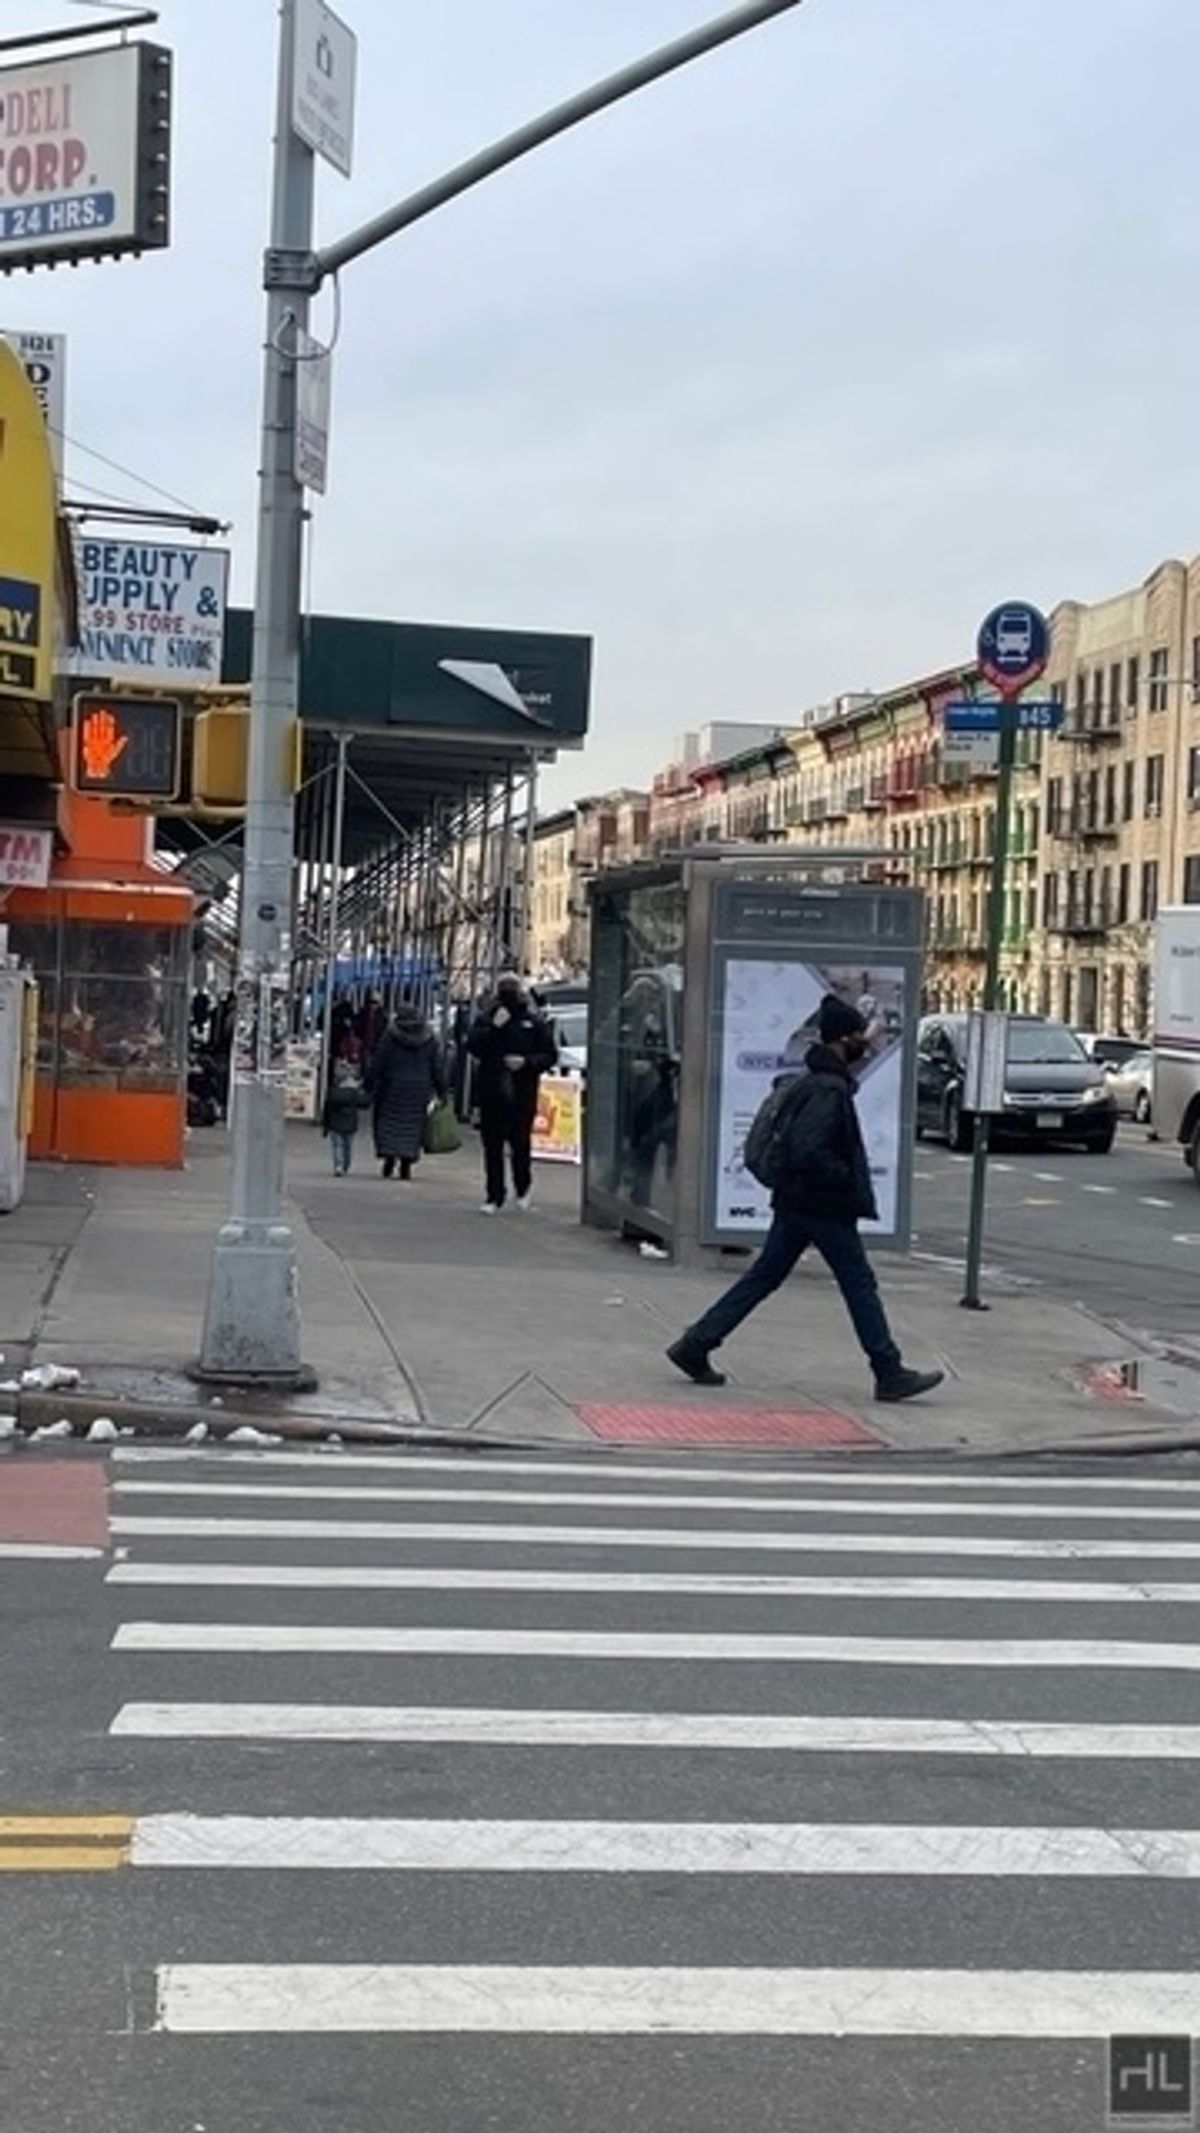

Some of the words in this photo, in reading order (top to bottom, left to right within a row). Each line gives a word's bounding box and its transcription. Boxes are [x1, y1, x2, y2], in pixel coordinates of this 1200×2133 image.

[6, 84, 71, 137] DELI
[0, 139, 97, 197] ORP.
[12, 206, 41, 236] 24
[49, 197, 104, 231] HRS.
[83, 543, 198, 581] BEAUTY
[196, 586, 218, 618] &
[126, 611, 185, 635] STORE
